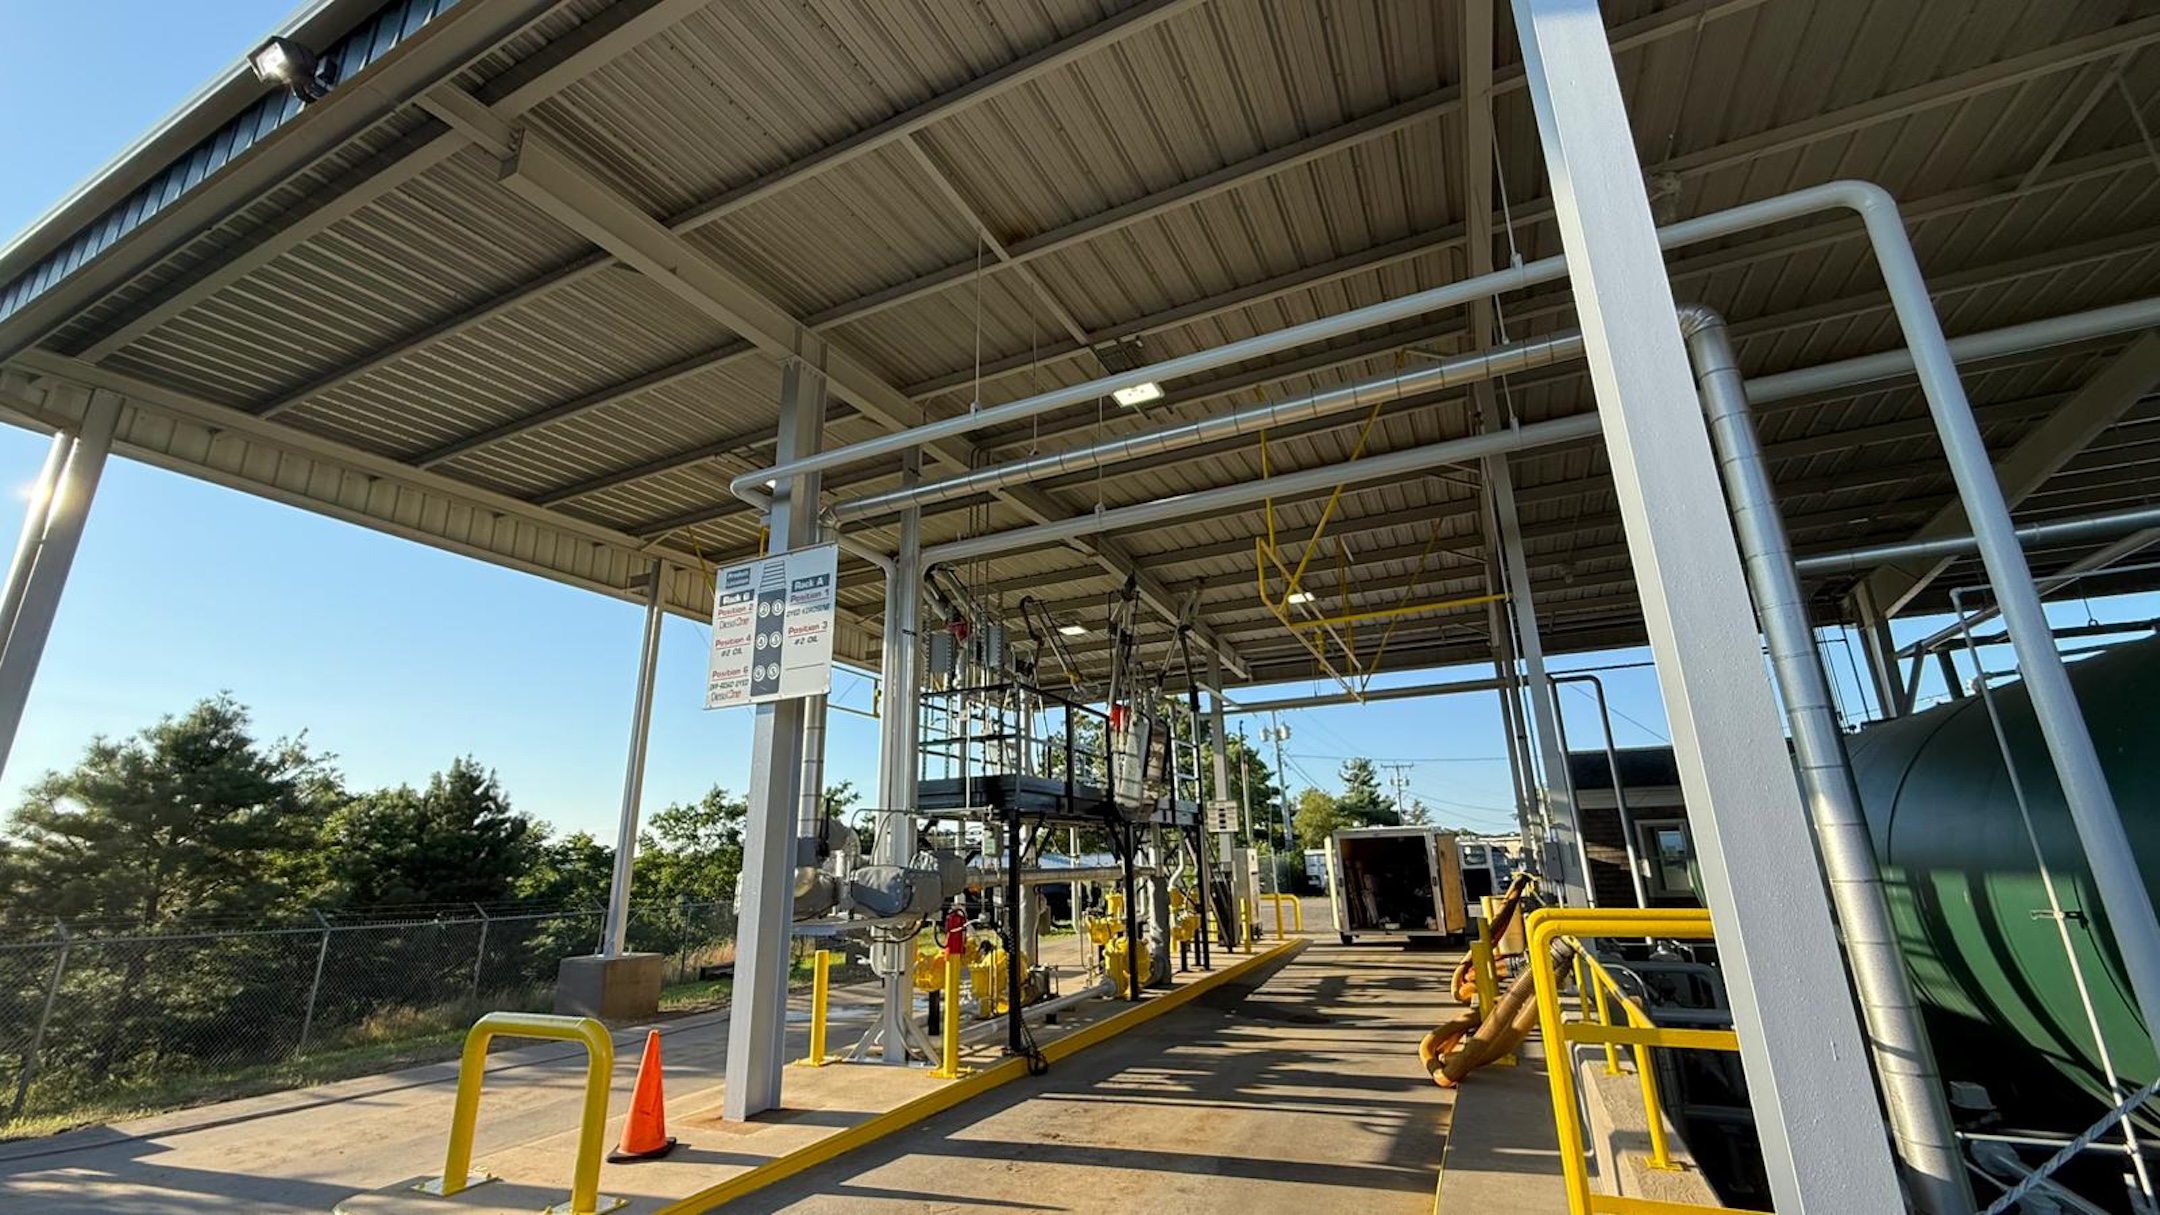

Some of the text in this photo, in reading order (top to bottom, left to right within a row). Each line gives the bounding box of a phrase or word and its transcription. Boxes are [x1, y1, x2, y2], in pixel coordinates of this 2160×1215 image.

[816, 577, 824, 586] A
[790, 592, 821, 603] Position
[718, 603, 754, 616] Position 2
[788, 621, 828, 635] Position 3
[715, 637, 744, 647] Position
[794, 635, 818, 645] #2 OIL
[712, 668, 741, 678] Position
